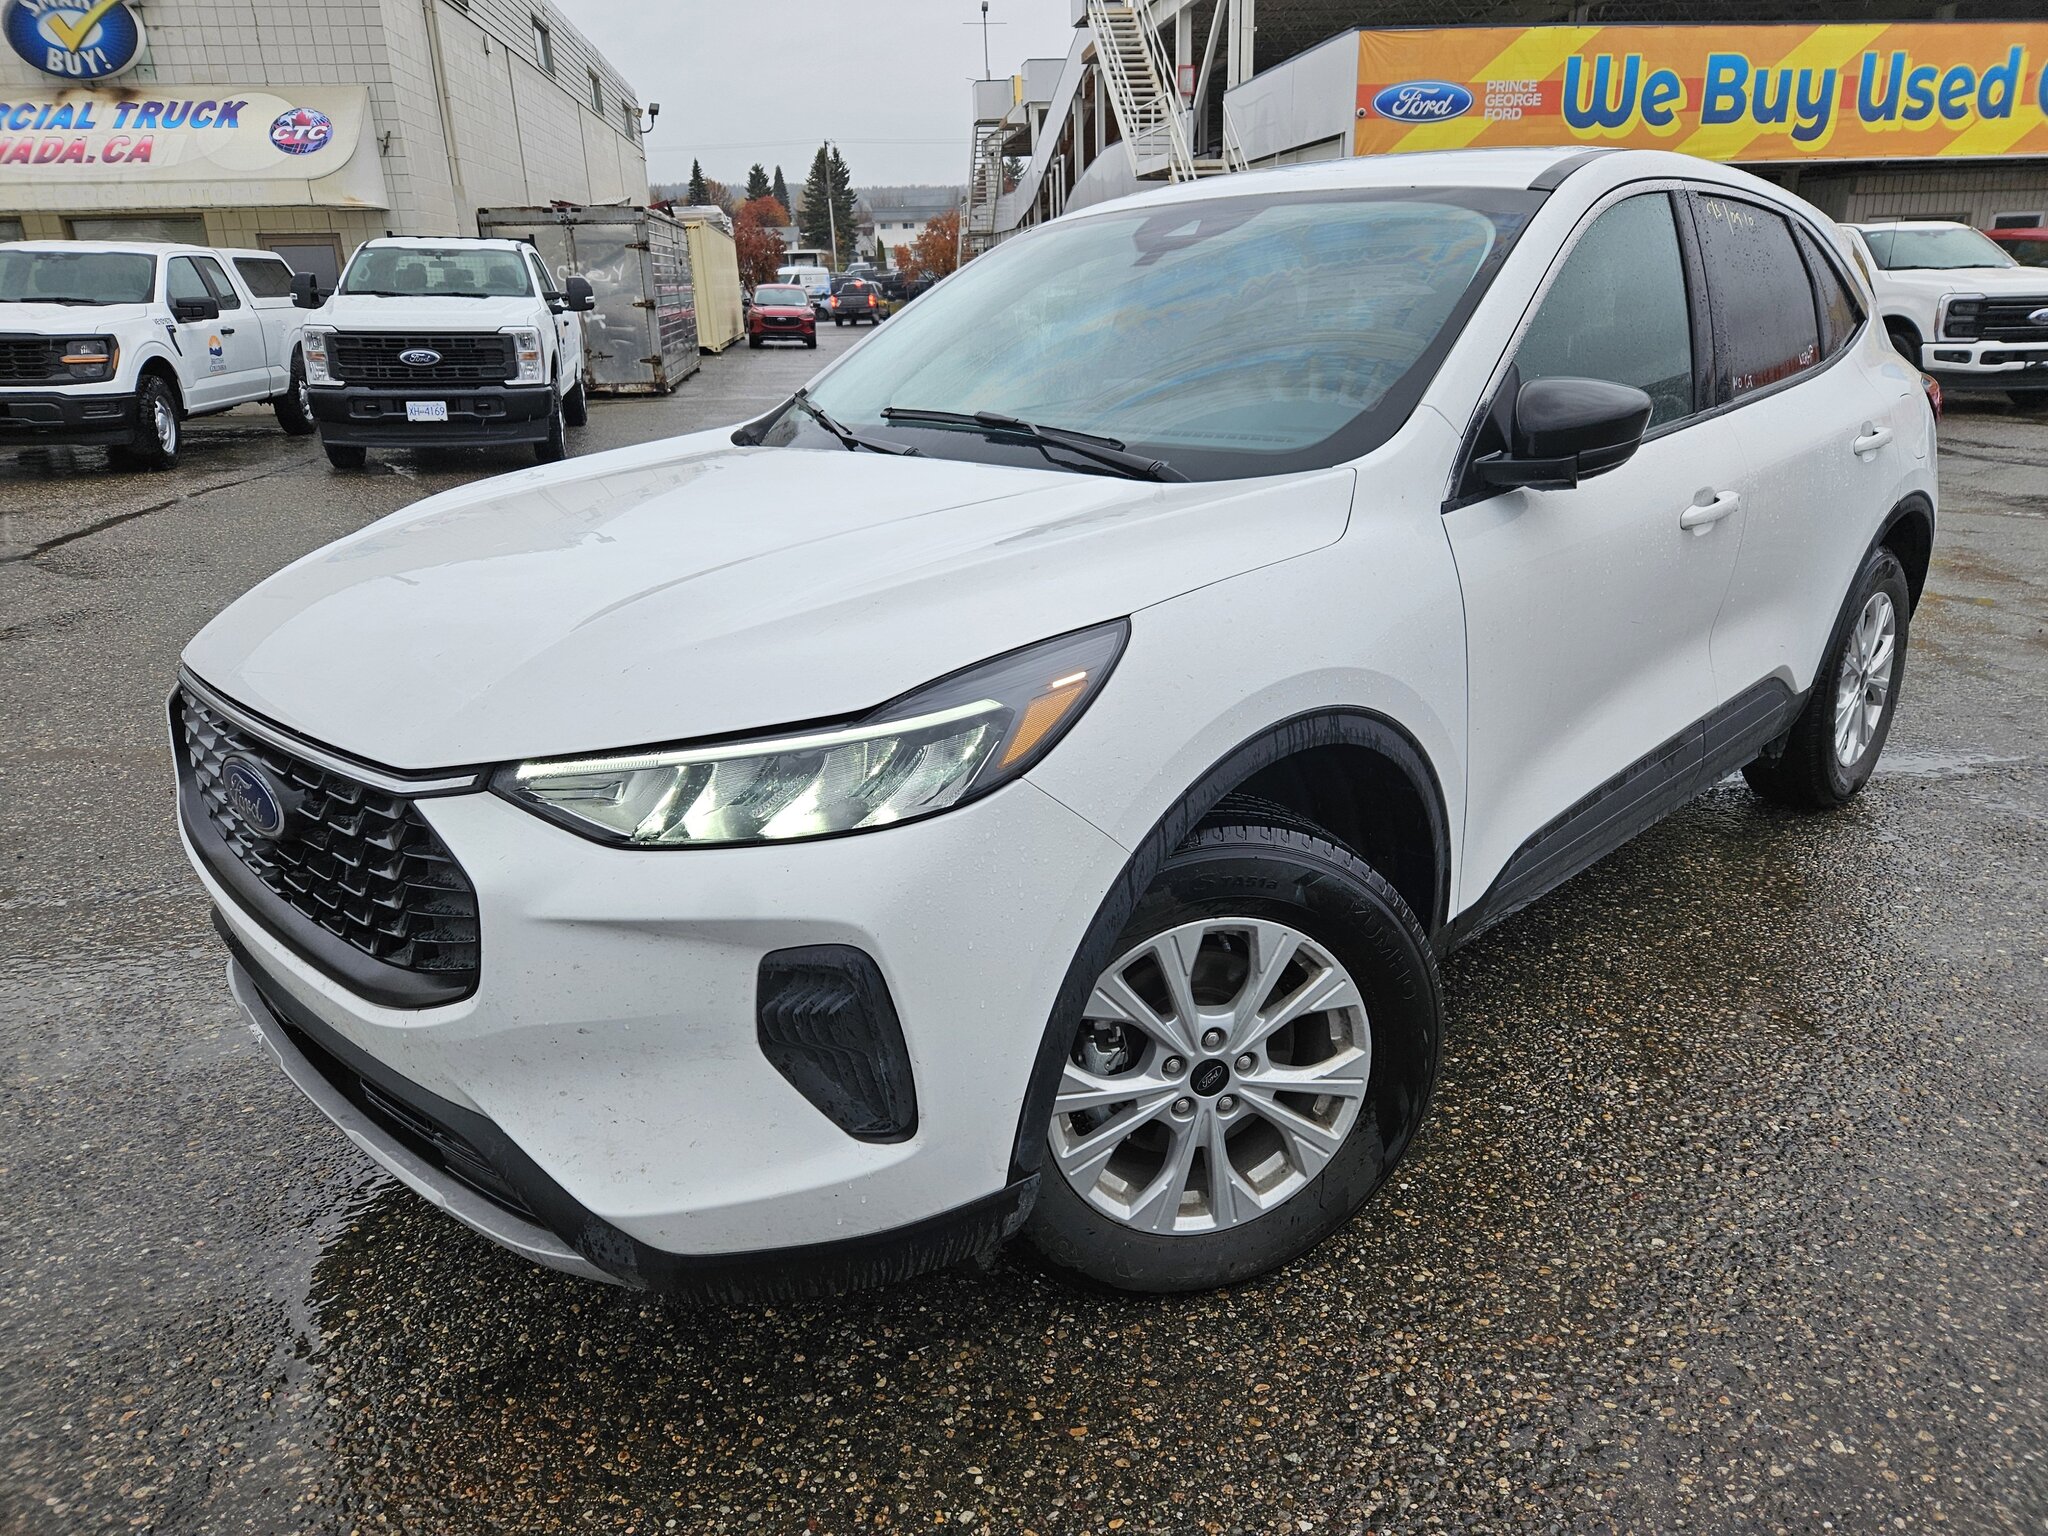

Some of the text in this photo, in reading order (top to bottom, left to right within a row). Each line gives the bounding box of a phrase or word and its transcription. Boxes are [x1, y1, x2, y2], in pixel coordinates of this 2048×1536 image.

[46, 47, 112, 75] BUY!
[1486, 80, 1538, 92] PRINCE
[1562, 54, 1683, 131] We
[1700, 52, 1839, 142] Buy
[1856, 44, 2026, 123] Used
[1391, 86, 1455, 117] Ford
[1484, 93, 1543, 107] GEORGE
[112, 100, 249, 129] TRUCK
[1483, 108, 1522, 121] FORD
[272, 125, 329, 140] CTC
